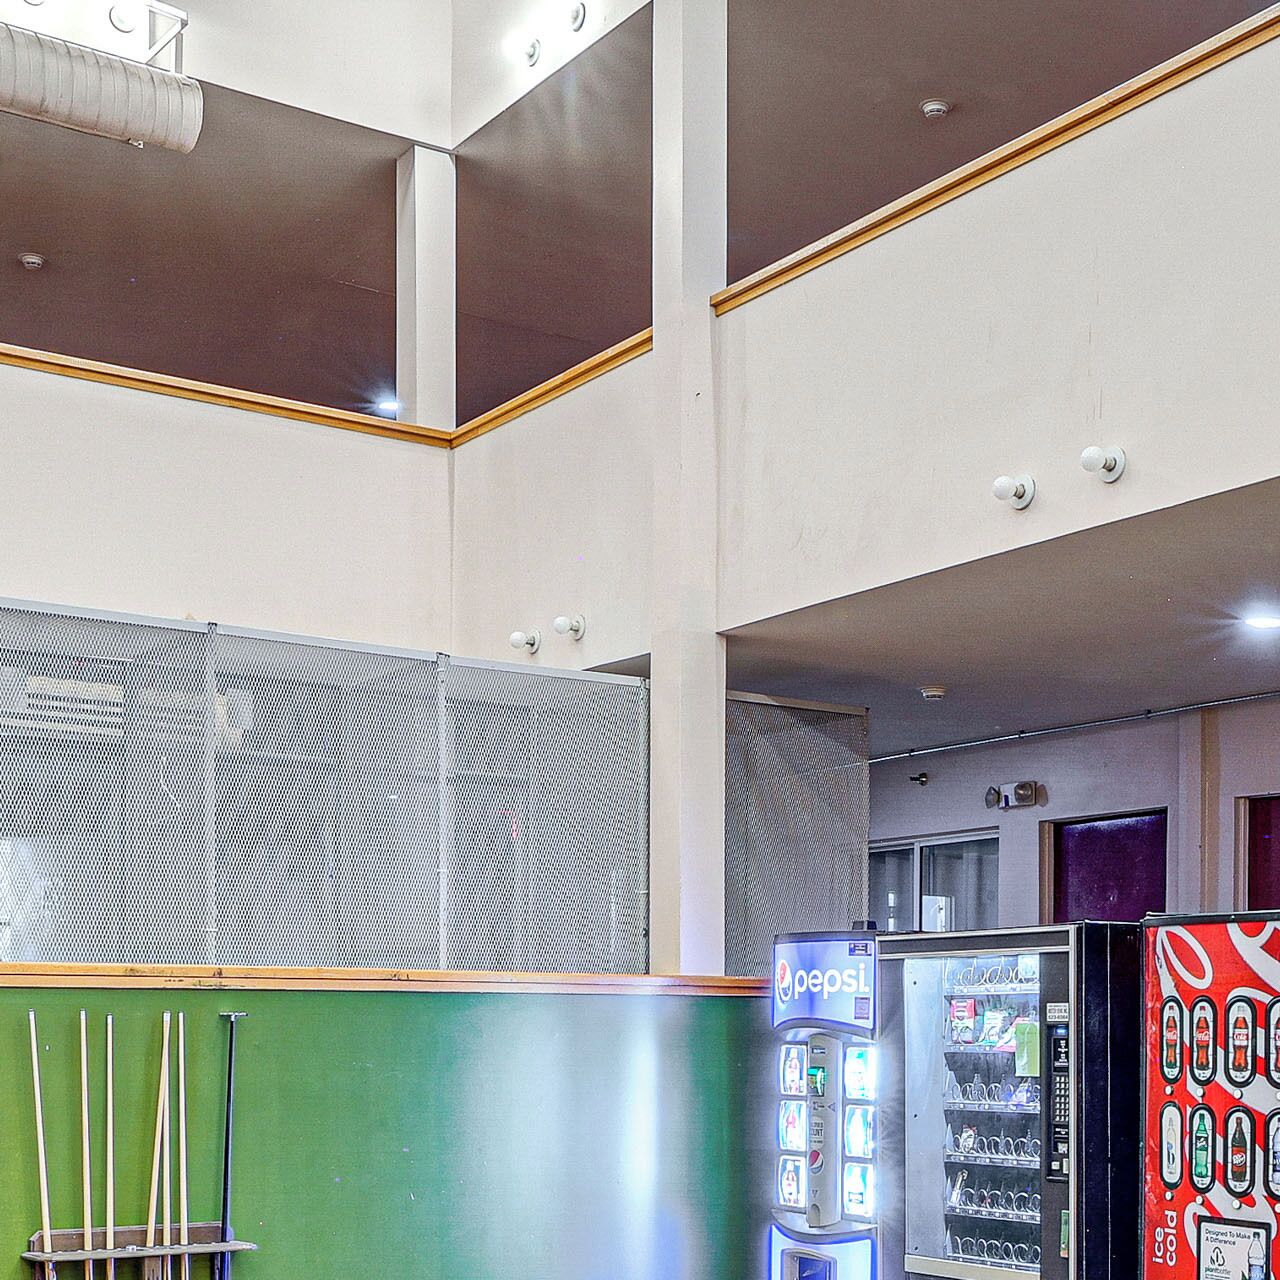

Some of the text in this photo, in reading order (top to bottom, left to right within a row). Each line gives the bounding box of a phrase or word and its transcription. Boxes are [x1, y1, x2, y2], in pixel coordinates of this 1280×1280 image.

[794, 962, 869, 1000] pepsi
[1152, 1226, 1164, 1264] ice
[1164, 1210, 1177, 1267] cold
[1205, 1228, 1227, 1237] Designed
